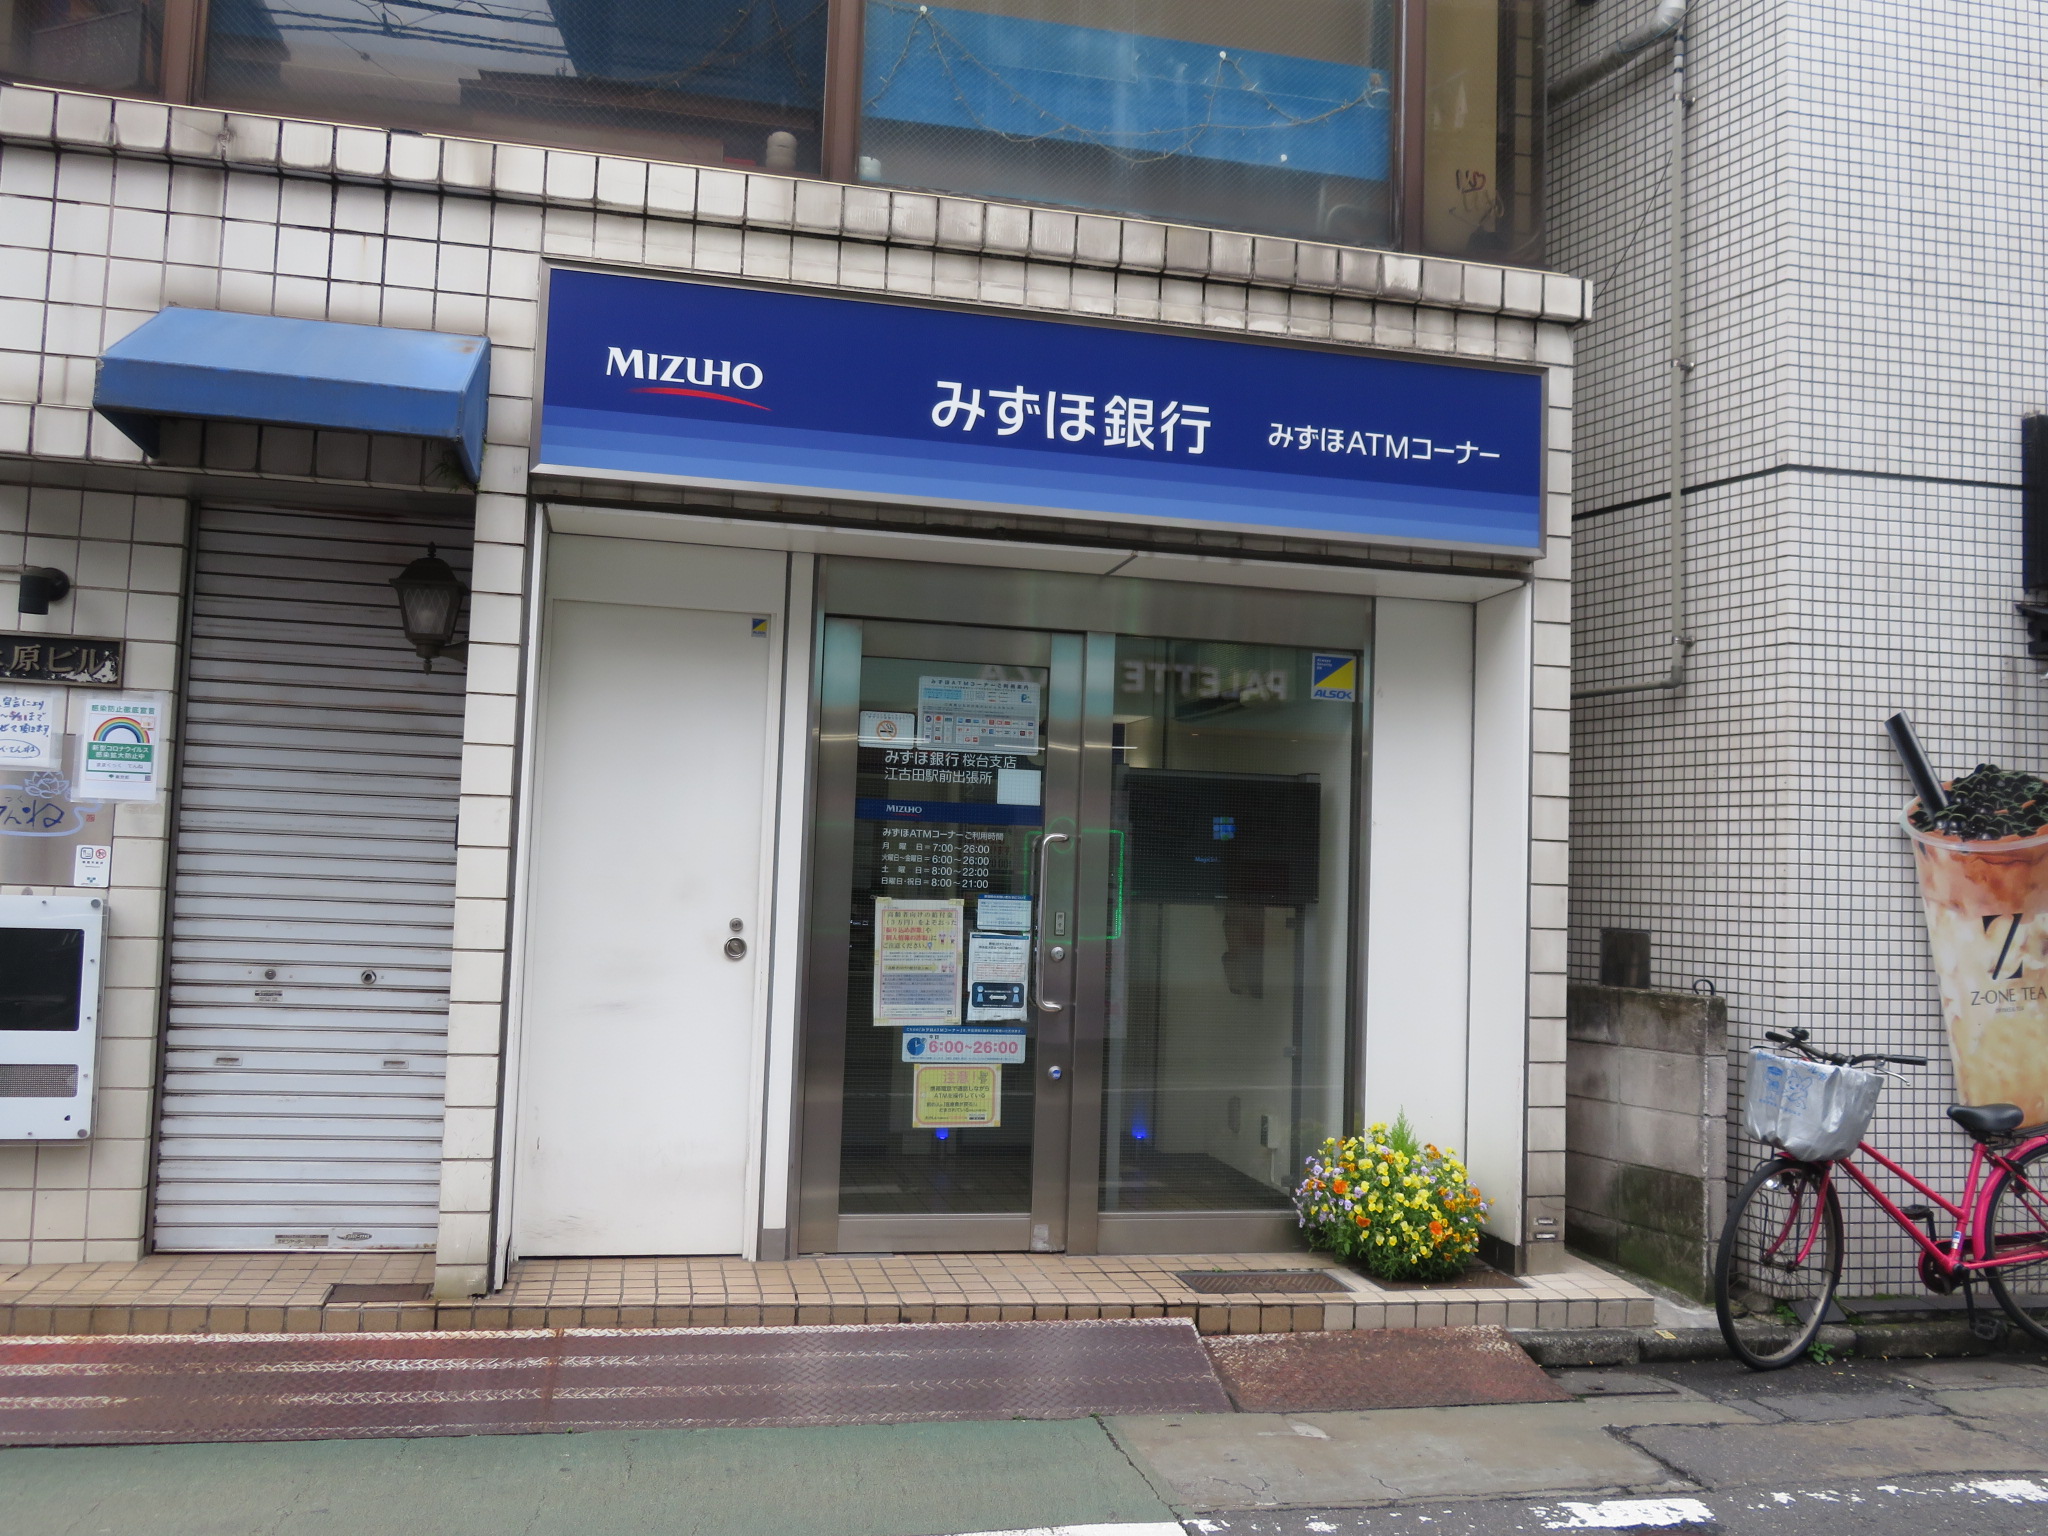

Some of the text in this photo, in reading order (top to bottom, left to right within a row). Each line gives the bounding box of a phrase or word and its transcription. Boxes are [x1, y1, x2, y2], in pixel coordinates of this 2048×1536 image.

[606, 346, 764, 390] MIZUHO
[931, 380, 1212, 454] みずほ銀行
[1268, 422, 1500, 465] みずほATMコーナー
[0, 644, 106, 676] 原ビル
[1314, 689, 1353, 700] ALSOK
[91, 704, 155, 715] 感染防止徹底宣言
[92, 744, 149, 753] 新型コロナウイルス
[95, 751, 146, 760] 感染拡大防止中
[884, 750, 1017, 769] みずほ銀行 桜台支店
[884, 767, 993, 785] 江古田駅前出張所
[886, 804, 922, 814] MIZUHO
[882, 827, 1004, 842] みずほATMコーナーご利用時間
[1971, 986, 2048, 1006] Z-ONE TEA
